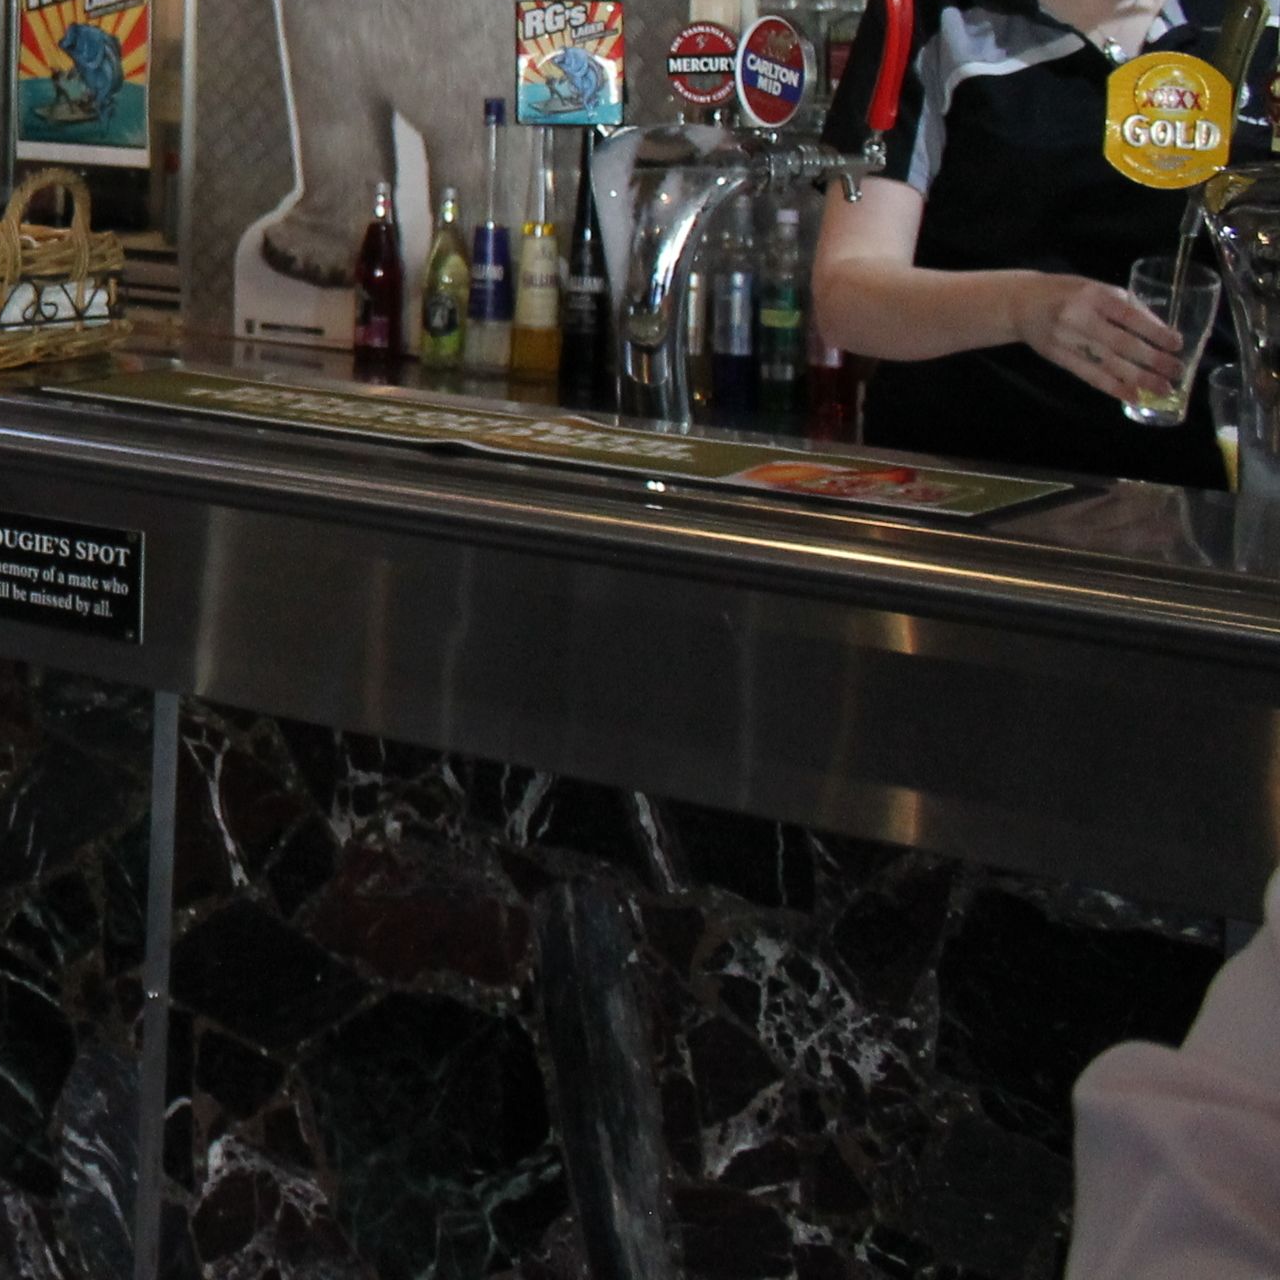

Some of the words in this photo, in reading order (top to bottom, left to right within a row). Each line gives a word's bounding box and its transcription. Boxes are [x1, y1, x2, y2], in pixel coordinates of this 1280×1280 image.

[668, 56, 737, 73] MERCURY
[746, 53, 800, 88] CARLTON
[757, 75, 782, 97] MID
[1122, 114, 1222, 151] GOLD
[75, 540, 131, 567] SPOT
[43, 566, 56, 583] of
[57, 570, 65, 584] a
[68, 572, 99, 590] mate
[102, 577, 130, 596] who
[12, 584, 27, 602] be
[30, 589, 72, 610] missed
[75, 595, 91, 616] by
[93, 601, 113, 618] all.
